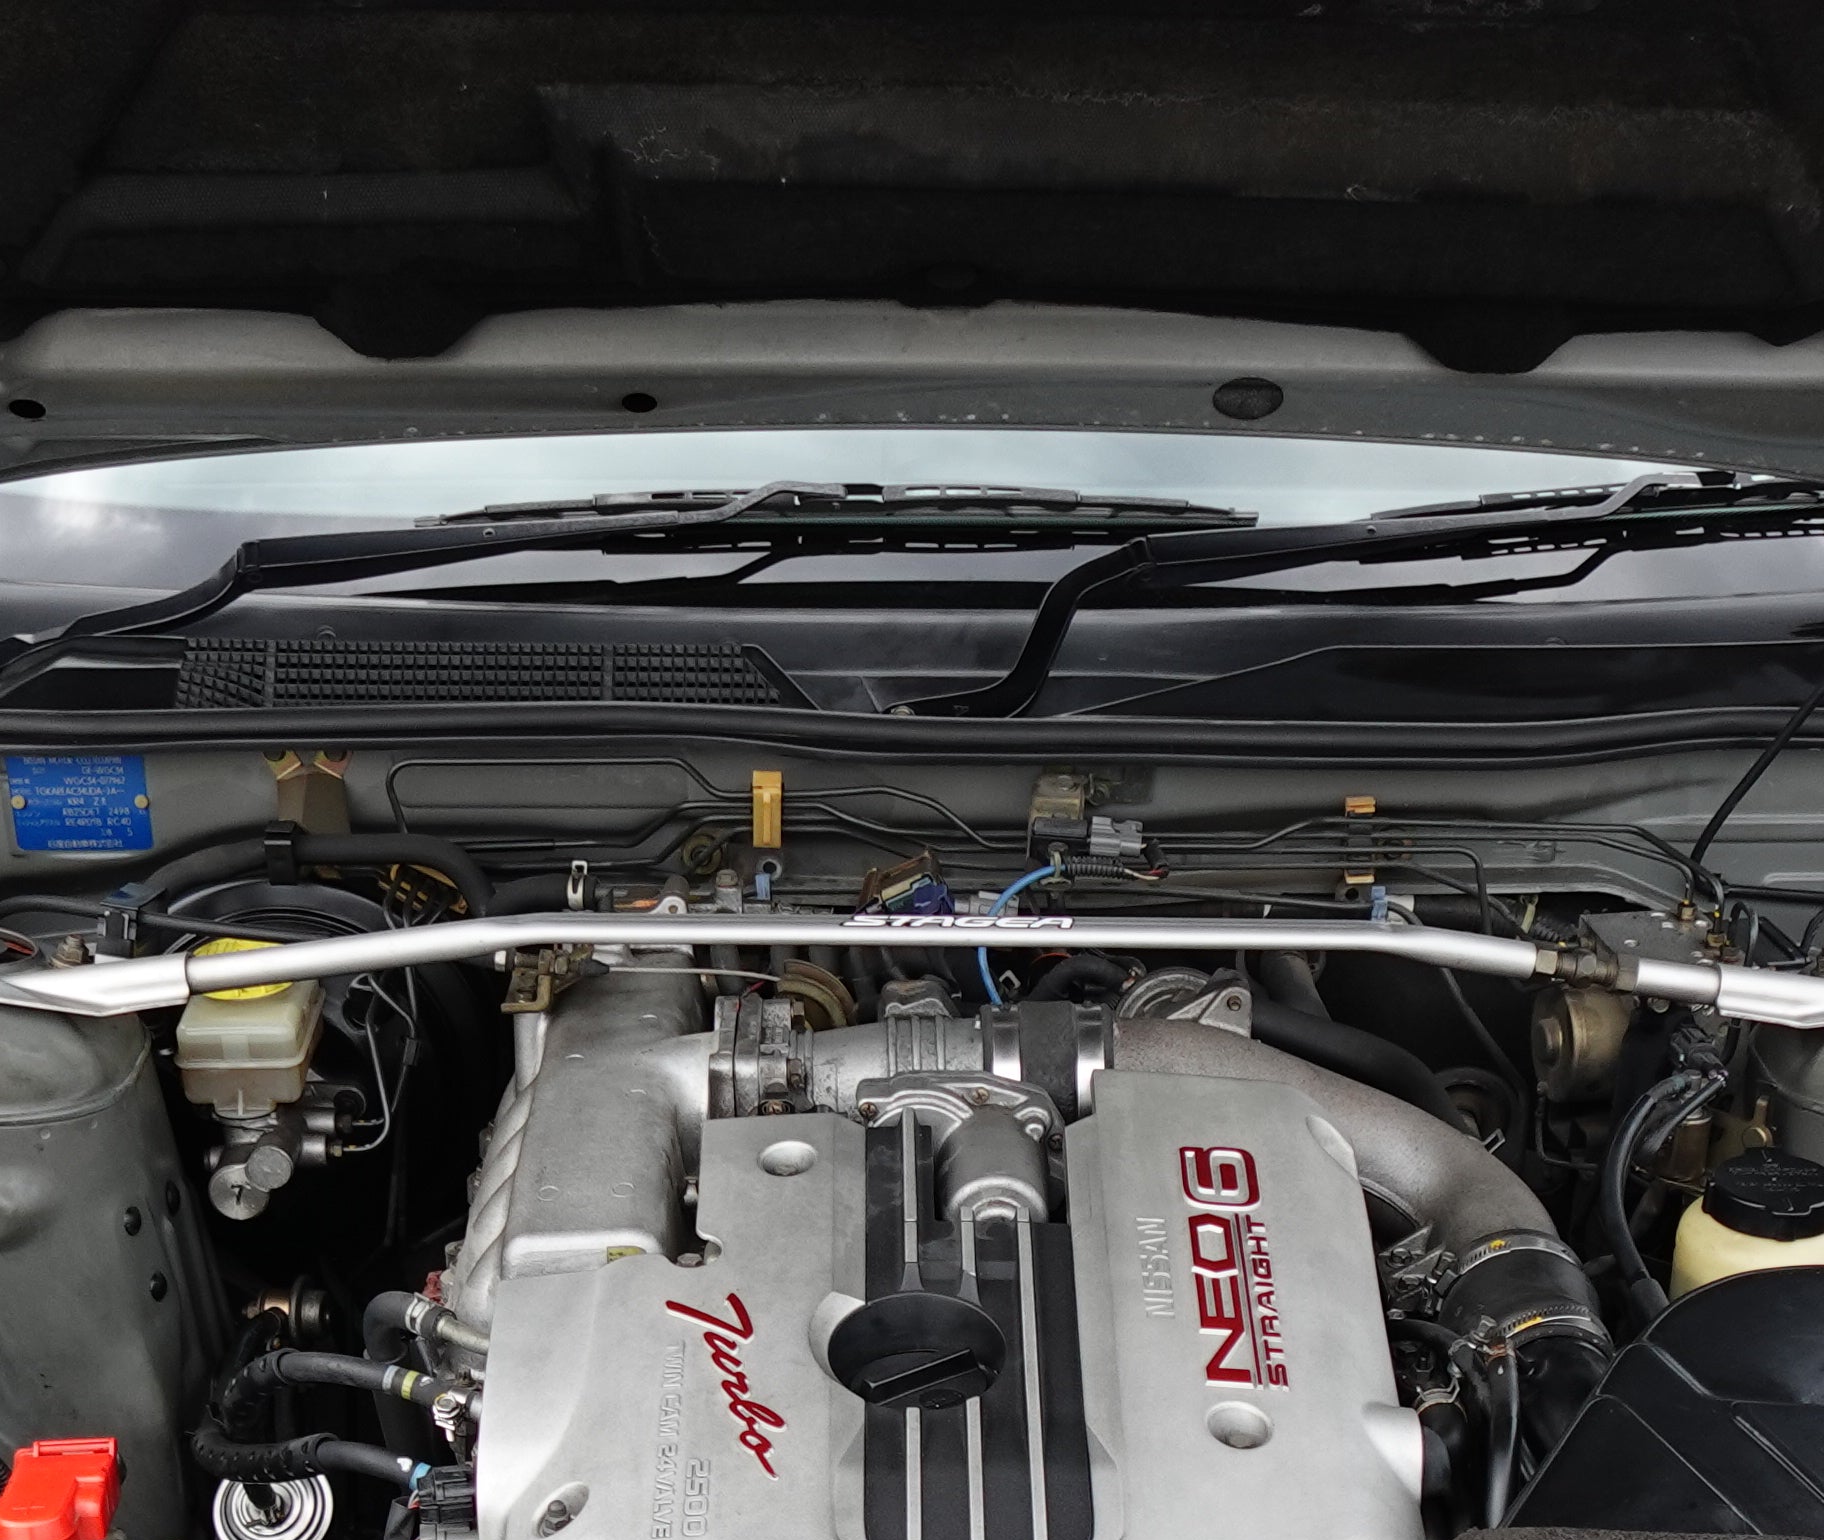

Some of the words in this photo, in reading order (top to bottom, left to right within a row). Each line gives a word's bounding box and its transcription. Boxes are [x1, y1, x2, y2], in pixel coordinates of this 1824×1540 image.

[841, 914, 1074, 929] STAGEA
[1179, 1146, 1261, 1211] 6
[1136, 1217, 1175, 1319] NISSAN
[1244, 1214, 1290, 1392] STRAIGHT
[665, 1292, 787, 1480] Turbo
[650, 1443, 678, 1540] 24VALVE
[682, 1456, 710, 1538] 2500
